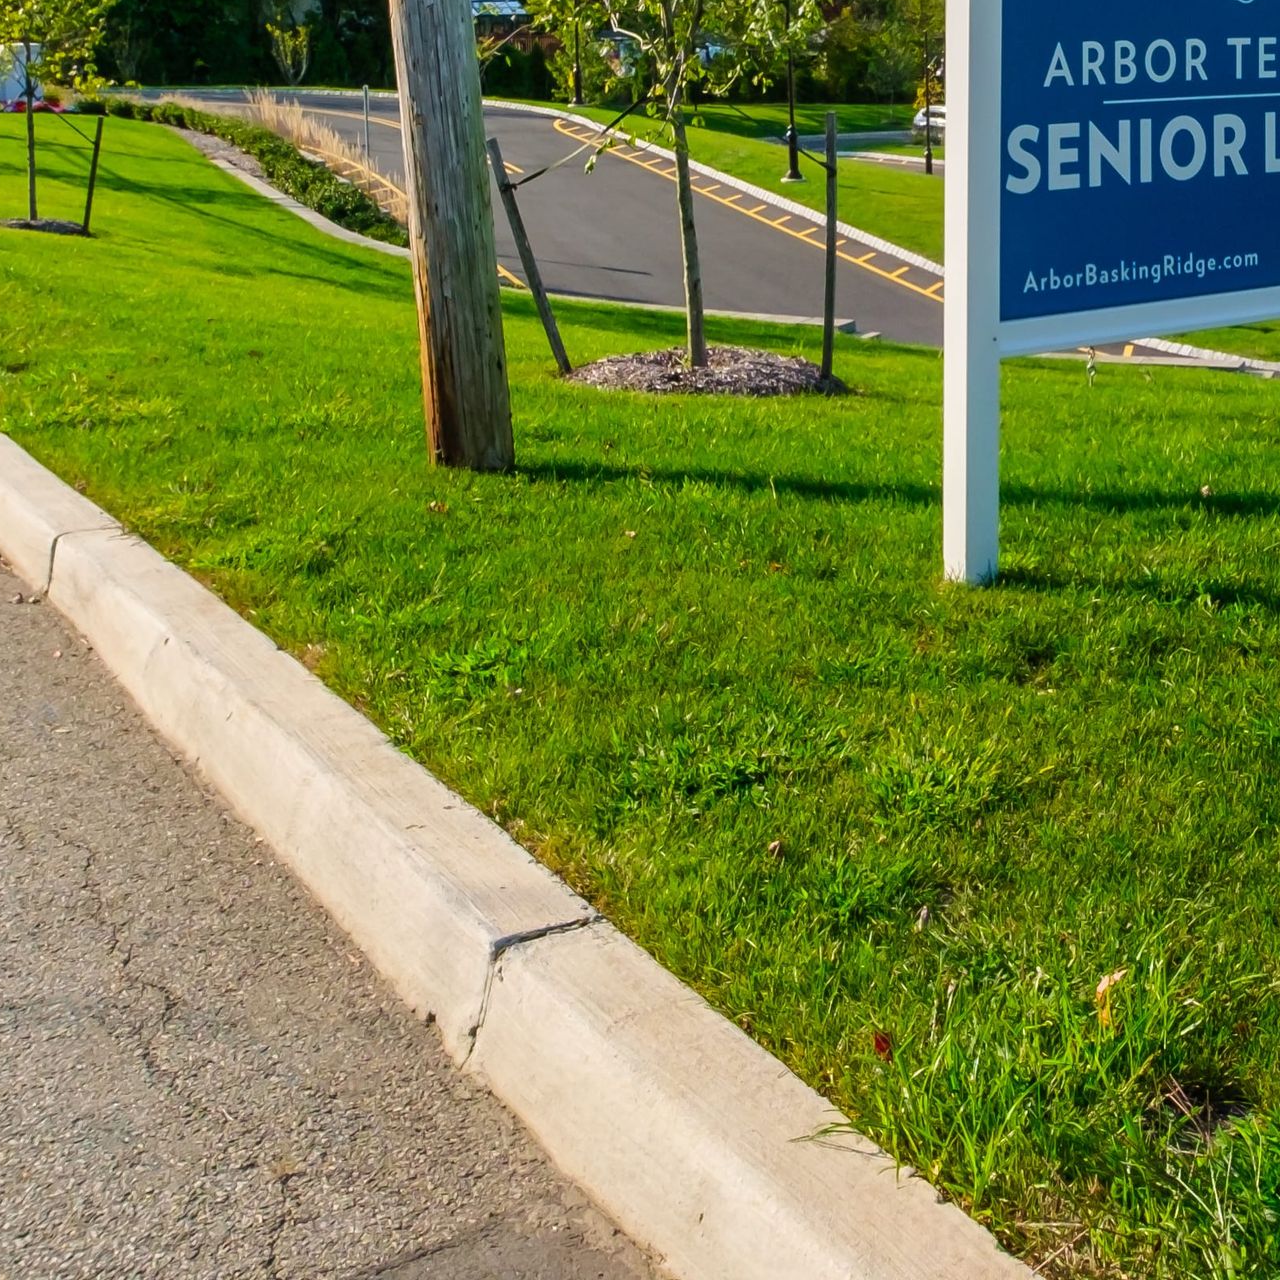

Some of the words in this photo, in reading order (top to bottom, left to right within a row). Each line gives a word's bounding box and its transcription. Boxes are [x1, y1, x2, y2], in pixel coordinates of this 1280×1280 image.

[1043, 38, 1208, 87] ARBOR
[1005, 113, 1249, 195] SENIOR
[1023, 252, 1259, 294] ArborBaskingRidge.com
